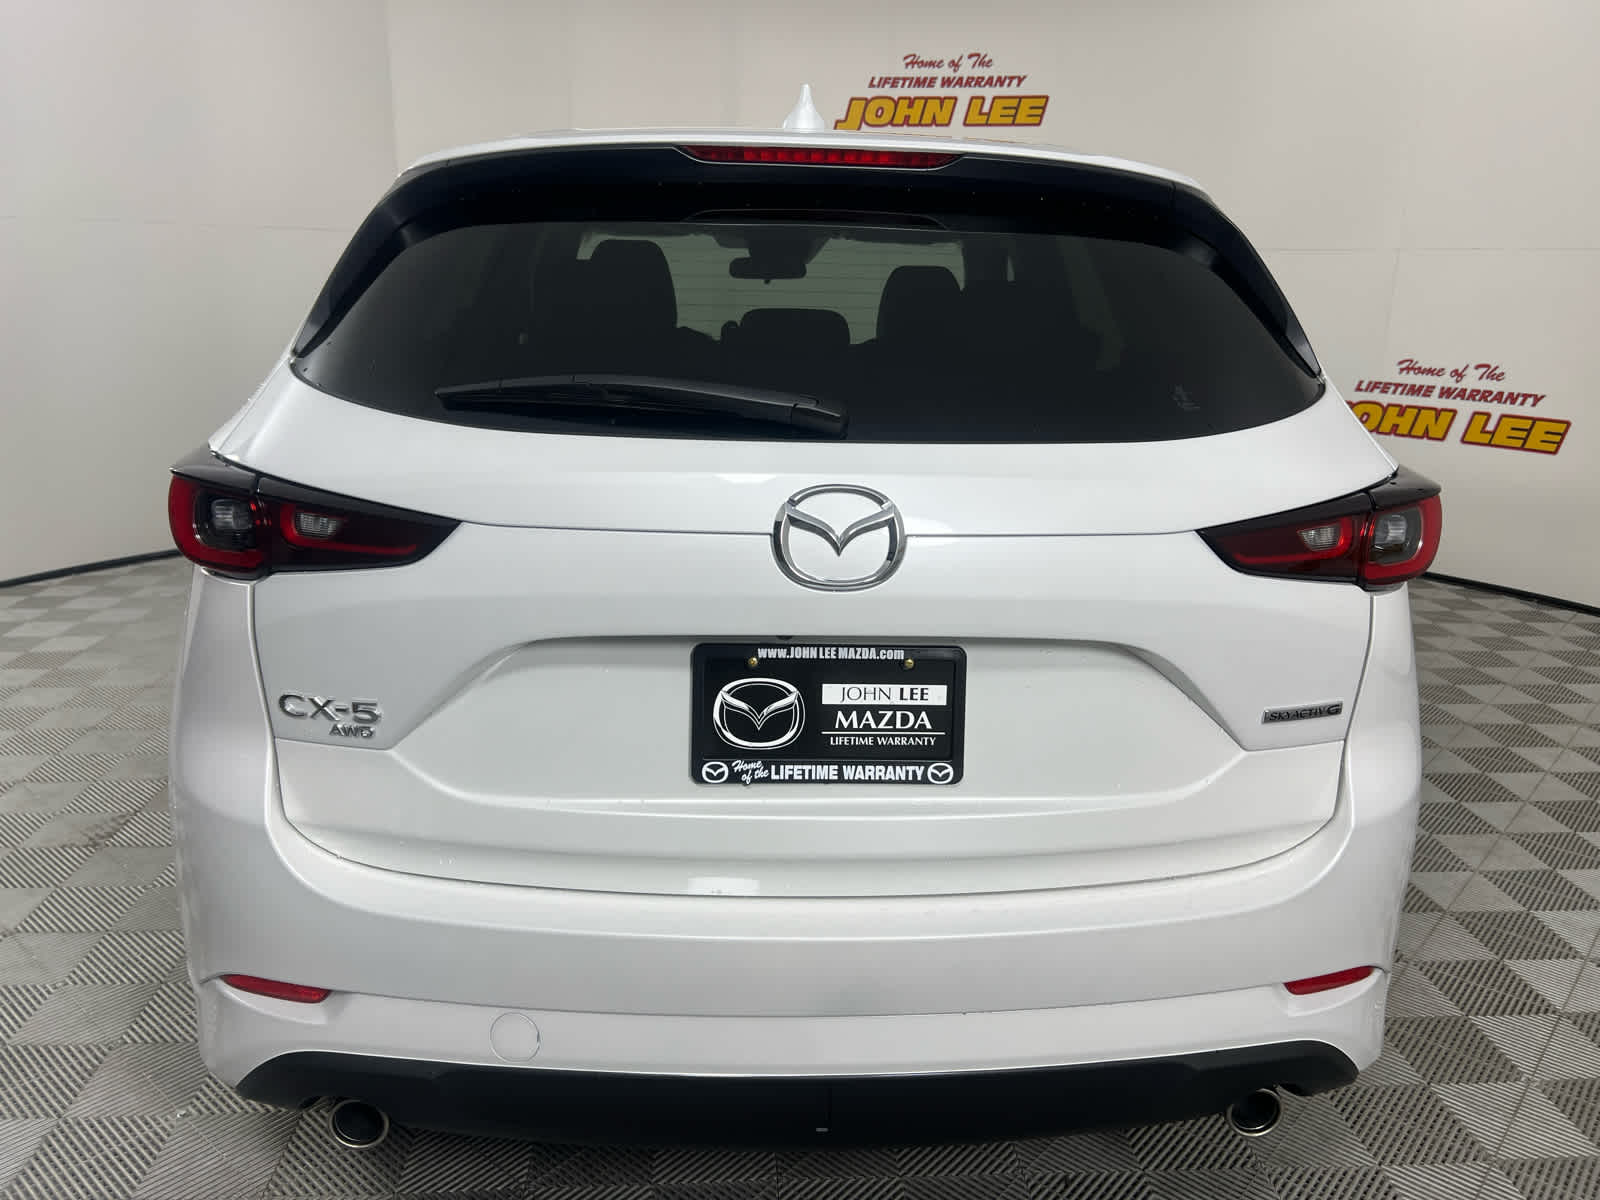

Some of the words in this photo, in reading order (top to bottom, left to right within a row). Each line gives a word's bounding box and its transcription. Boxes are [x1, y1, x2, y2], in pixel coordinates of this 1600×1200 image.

[903, 53, 944, 69] Home
[947, 54, 964, 73] of
[967, 52, 993, 69] The
[868, 76, 938, 88] LIFETIME
[940, 75, 1027, 88] WARRANTY
[834, 95, 957, 131] JOHN
[963, 95, 1049, 127] LEE
[1397, 359, 1445, 377] Home
[1449, 364, 1469, 383] of
[1474, 364, 1505, 382] The
[1355, 380, 1435, 398] LIFETIME
[1438, 386, 1546, 408] WARRANTY
[1344, 400, 1457, 442] OHN
[1460, 411, 1571, 456] LEE
[841, 687, 892, 702] JOHN
[899, 688, 929, 702] LEE
[279, 694, 381, 724] CX-5
[835, 711, 932, 729] MAZDA
[329, 723, 374, 738] AWD
[830, 737, 875, 746] LIFETIME
[877, 737, 936, 746] WARRANTY
[731, 760, 763, 773] Home
[741, 769, 753, 785] of
[754, 765, 770, 779] the
[770, 764, 838, 780] LIFETIME
[843, 764, 925, 781] WARRANTY
